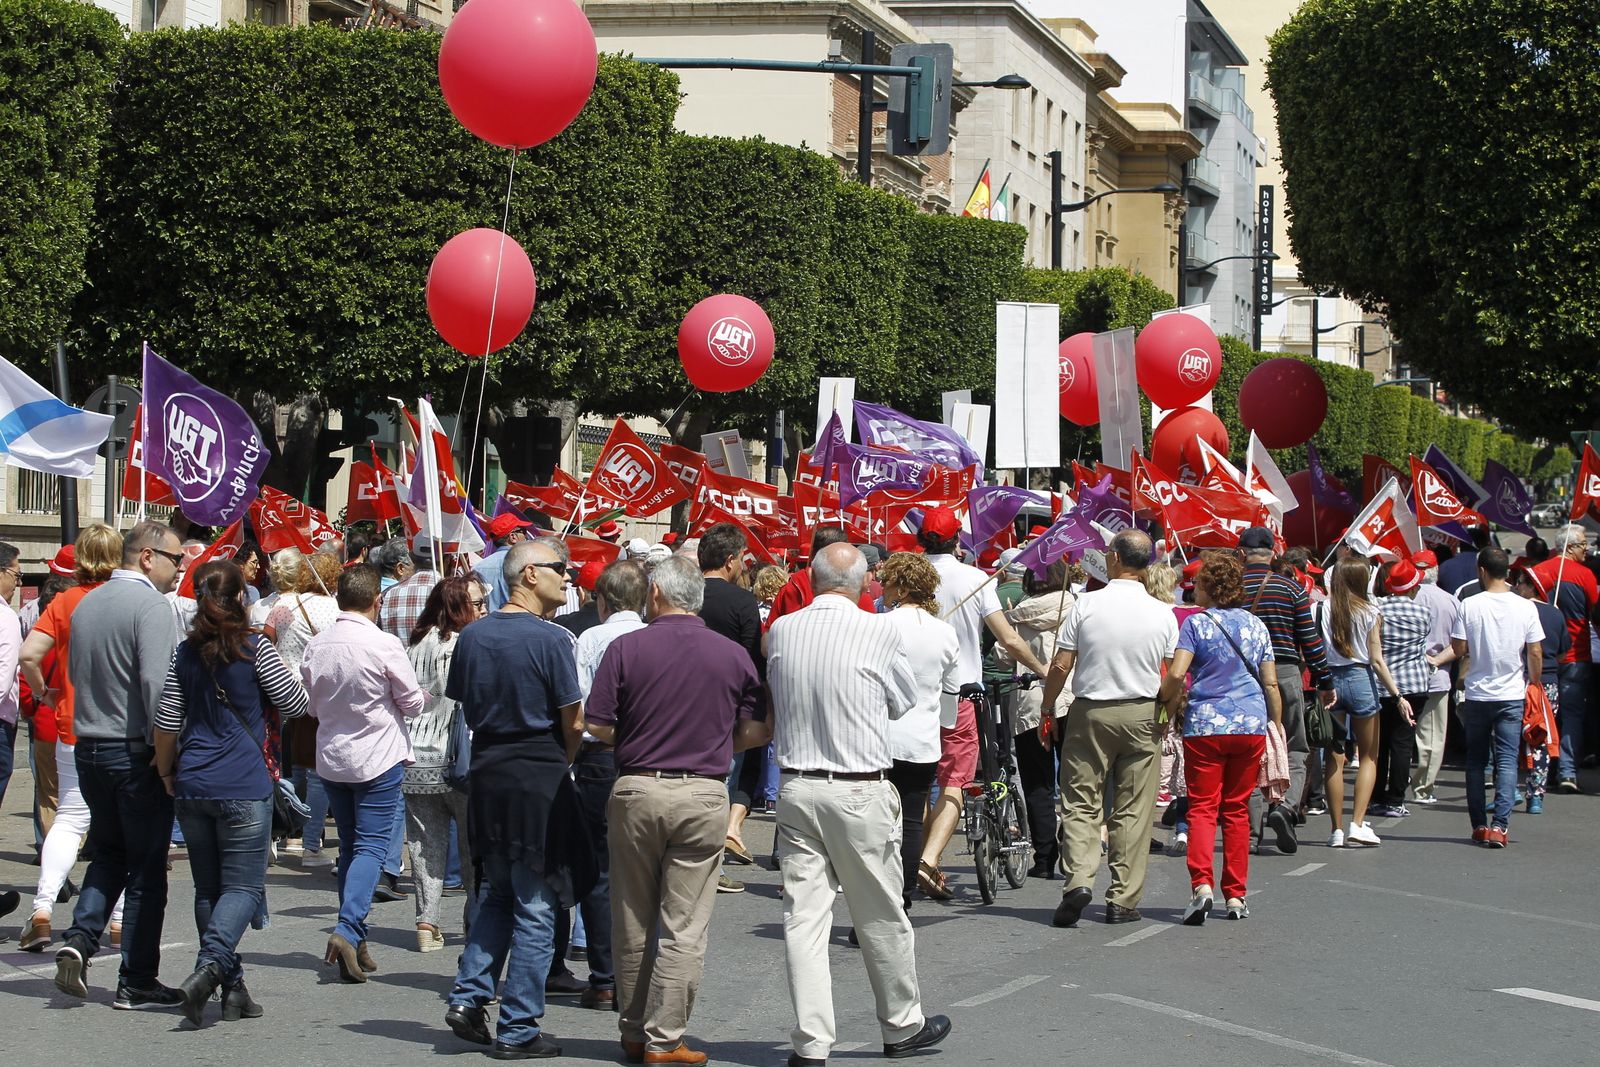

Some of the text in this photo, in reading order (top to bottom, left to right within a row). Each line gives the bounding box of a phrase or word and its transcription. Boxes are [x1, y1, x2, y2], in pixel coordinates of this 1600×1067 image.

[715, 321, 752, 351] UGT
[1184, 354, 1208, 372] UGT
[169, 403, 218, 468] UGT
[606, 447, 653, 493] UGT
[1102, 511, 1130, 534] UG
